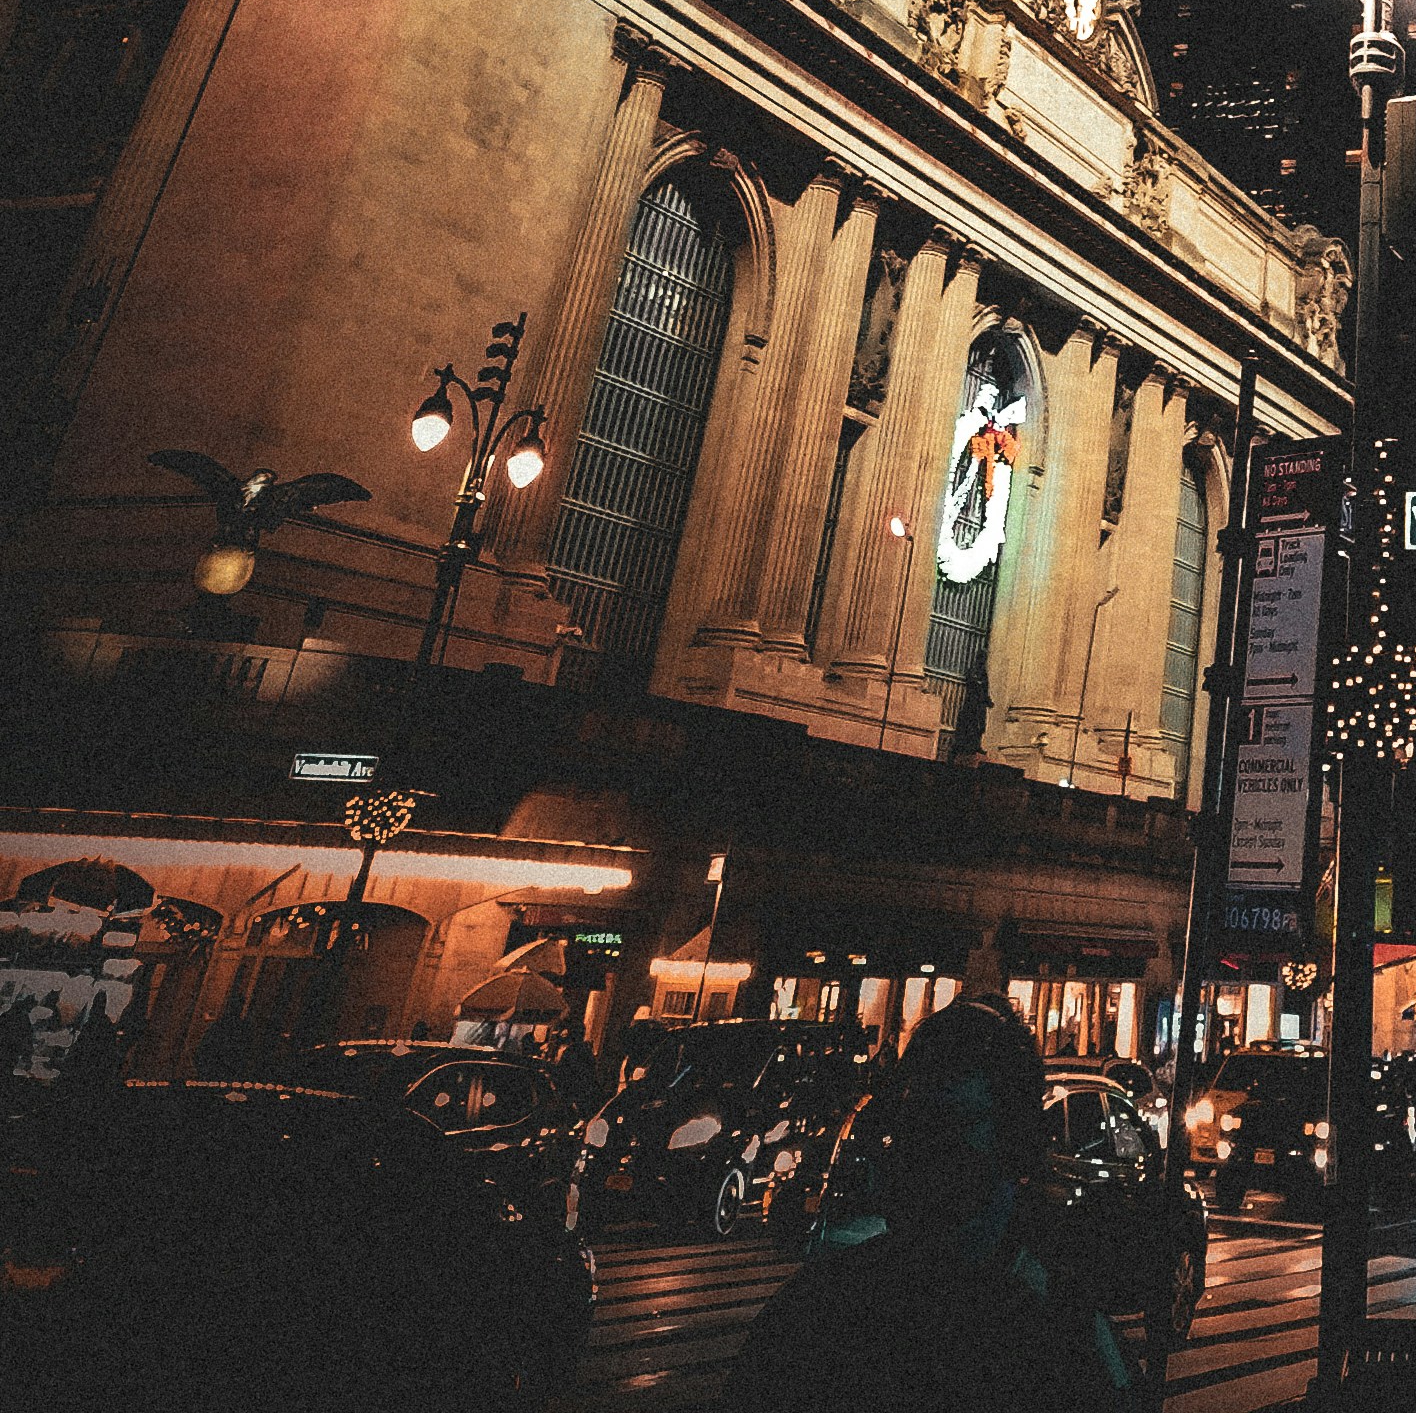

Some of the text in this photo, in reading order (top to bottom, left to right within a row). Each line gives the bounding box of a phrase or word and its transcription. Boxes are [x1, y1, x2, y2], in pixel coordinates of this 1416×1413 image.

[1264, 457, 1321, 477] NO STANDING
[1238, 758, 1297, 774] COMMERCIAL
[1237, 777, 1304, 793] VEHICLES ONLY
